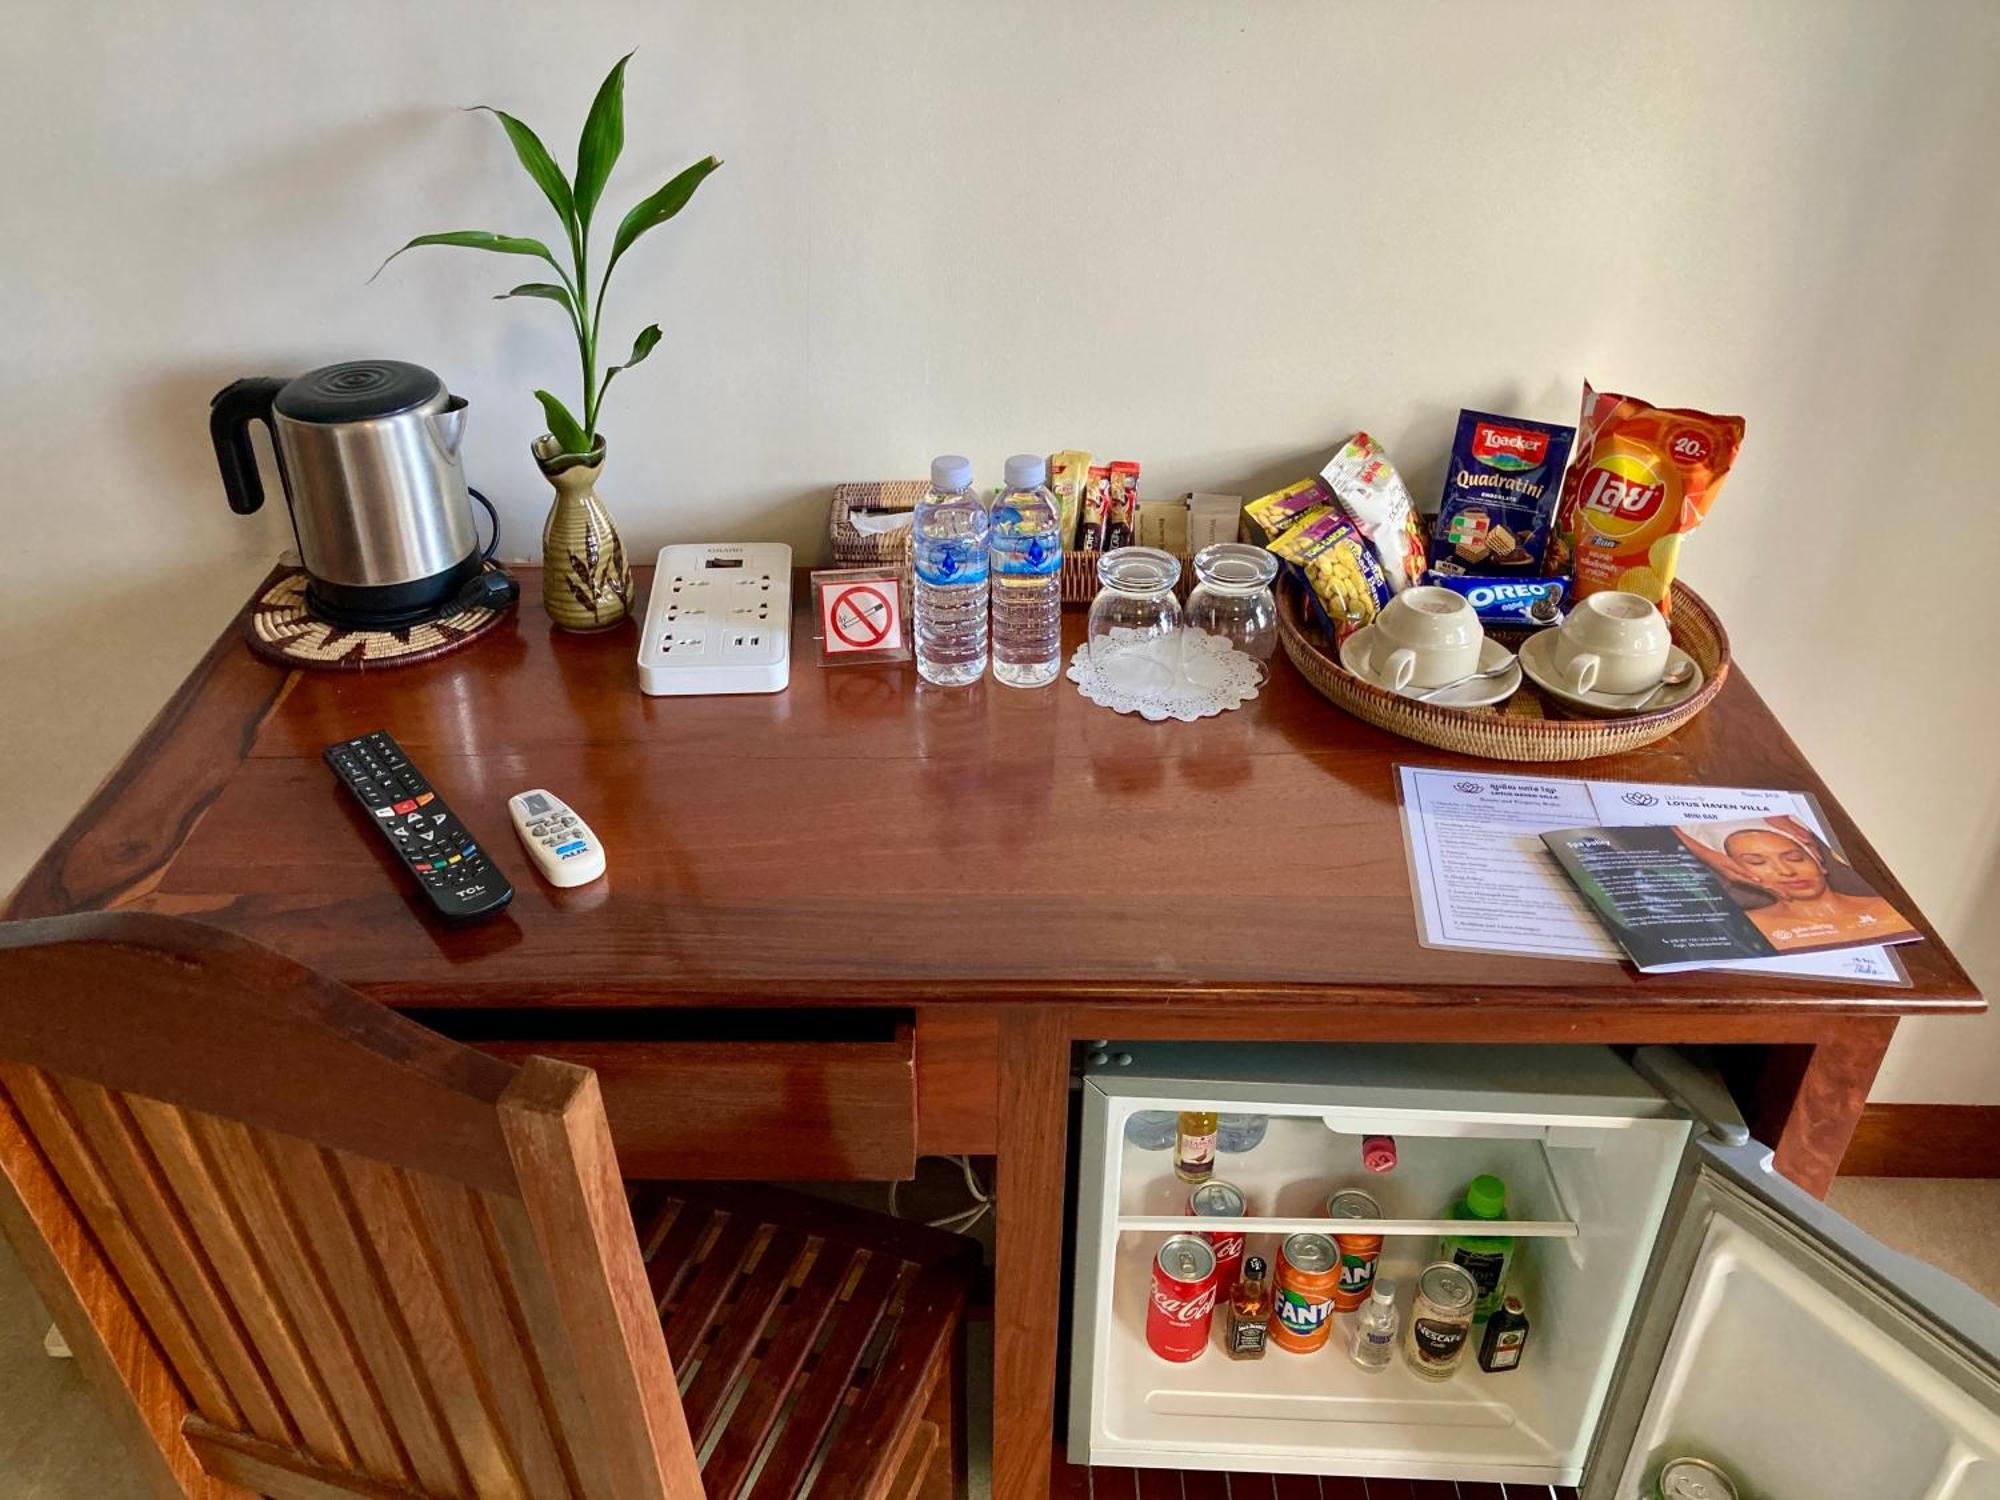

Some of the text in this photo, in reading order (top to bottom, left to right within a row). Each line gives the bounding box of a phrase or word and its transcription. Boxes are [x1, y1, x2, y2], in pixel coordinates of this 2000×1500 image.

[1482, 429, 1542, 451] Loacker
[1456, 470, 1544, 499] Quadratini
[1467, 584, 1546, 608] OREO
[1666, 800, 1771, 812] LOTUS HAVEN VILLA
[455, 885, 485, 897] TCL
